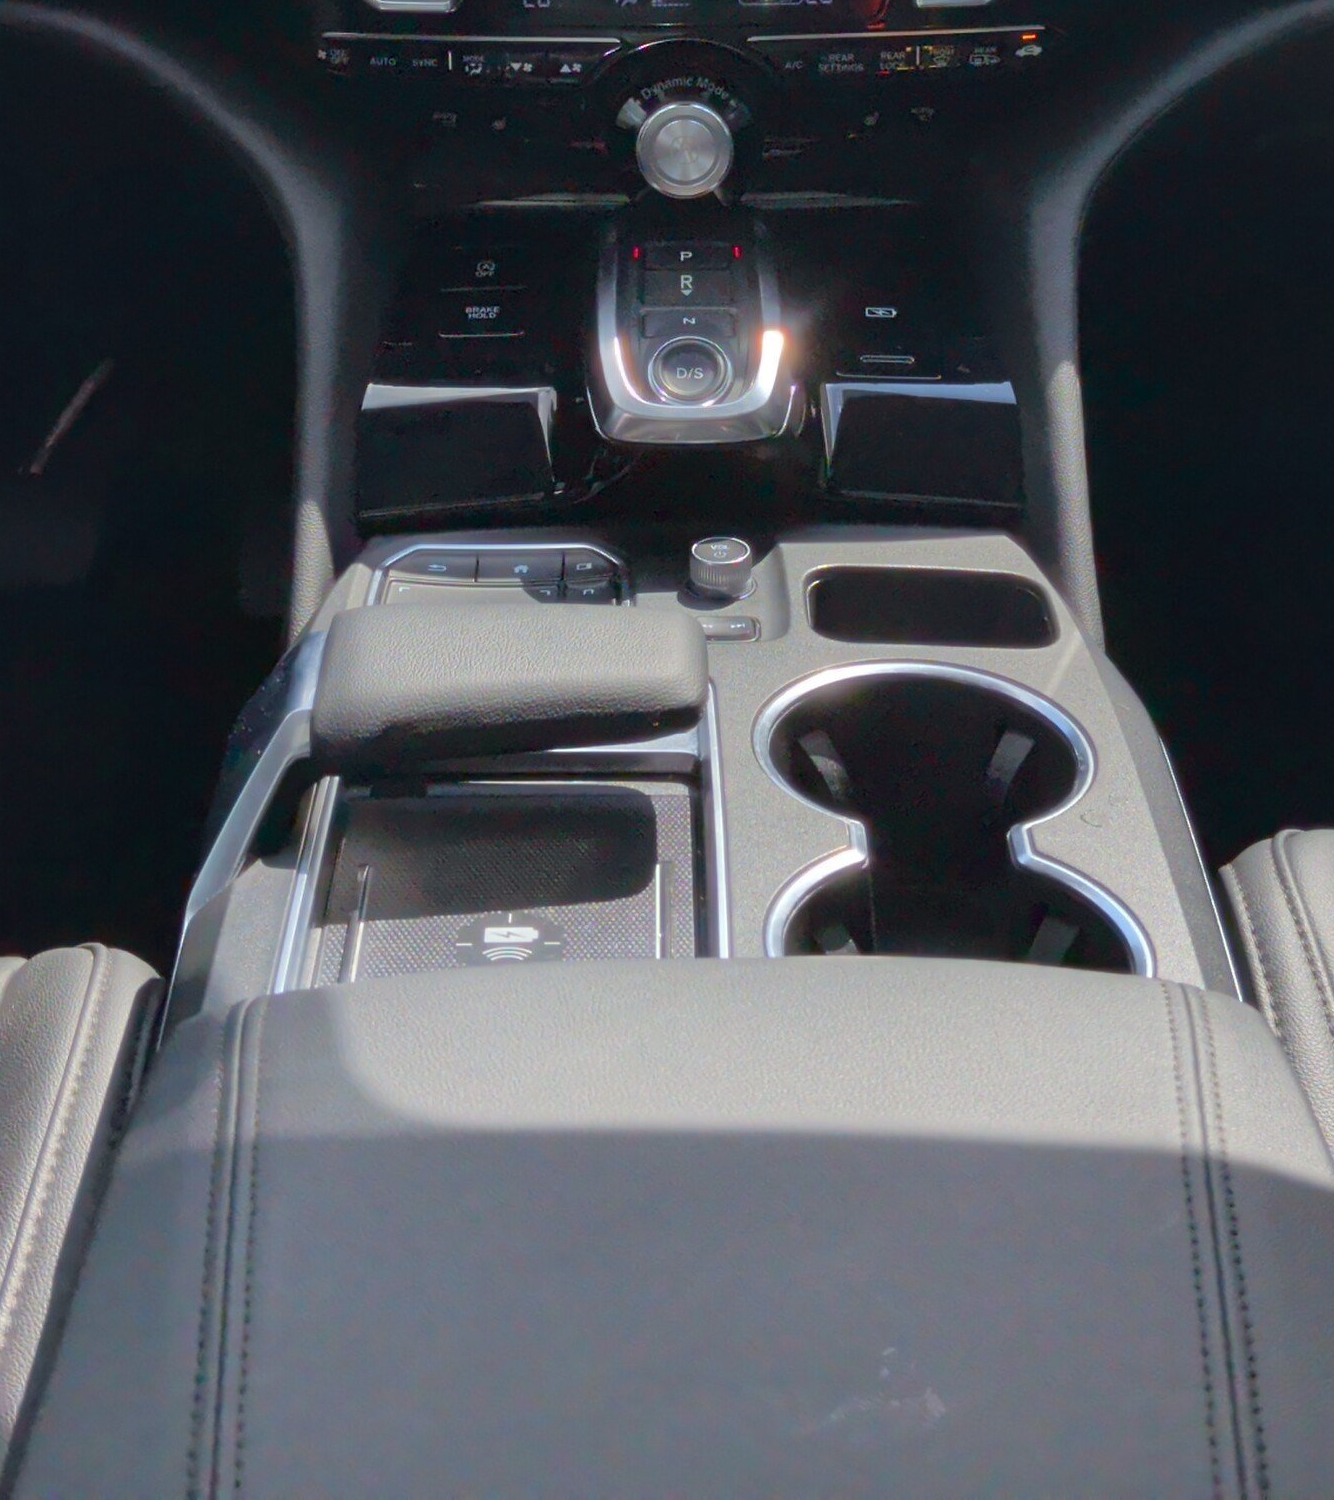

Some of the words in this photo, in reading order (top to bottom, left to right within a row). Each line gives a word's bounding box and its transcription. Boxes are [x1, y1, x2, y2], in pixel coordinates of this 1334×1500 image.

[828, 53, 855, 62] REAR
[880, 51, 906, 60] REAR
[369, 56, 397, 67] AUTO
[412, 57, 438, 68] SYNC
[784, 60, 803, 70] A/C
[818, 63, 865, 73] SETTINGS
[640, 76, 694, 100] Dynamic
[696, 76, 731, 100] Mode
[680, 251, 693, 261] P
[680, 275, 693, 289] R
[465, 306, 501, 314] BRAKE
[683, 317, 696, 325] N
[676, 367, 704, 380] D/S
